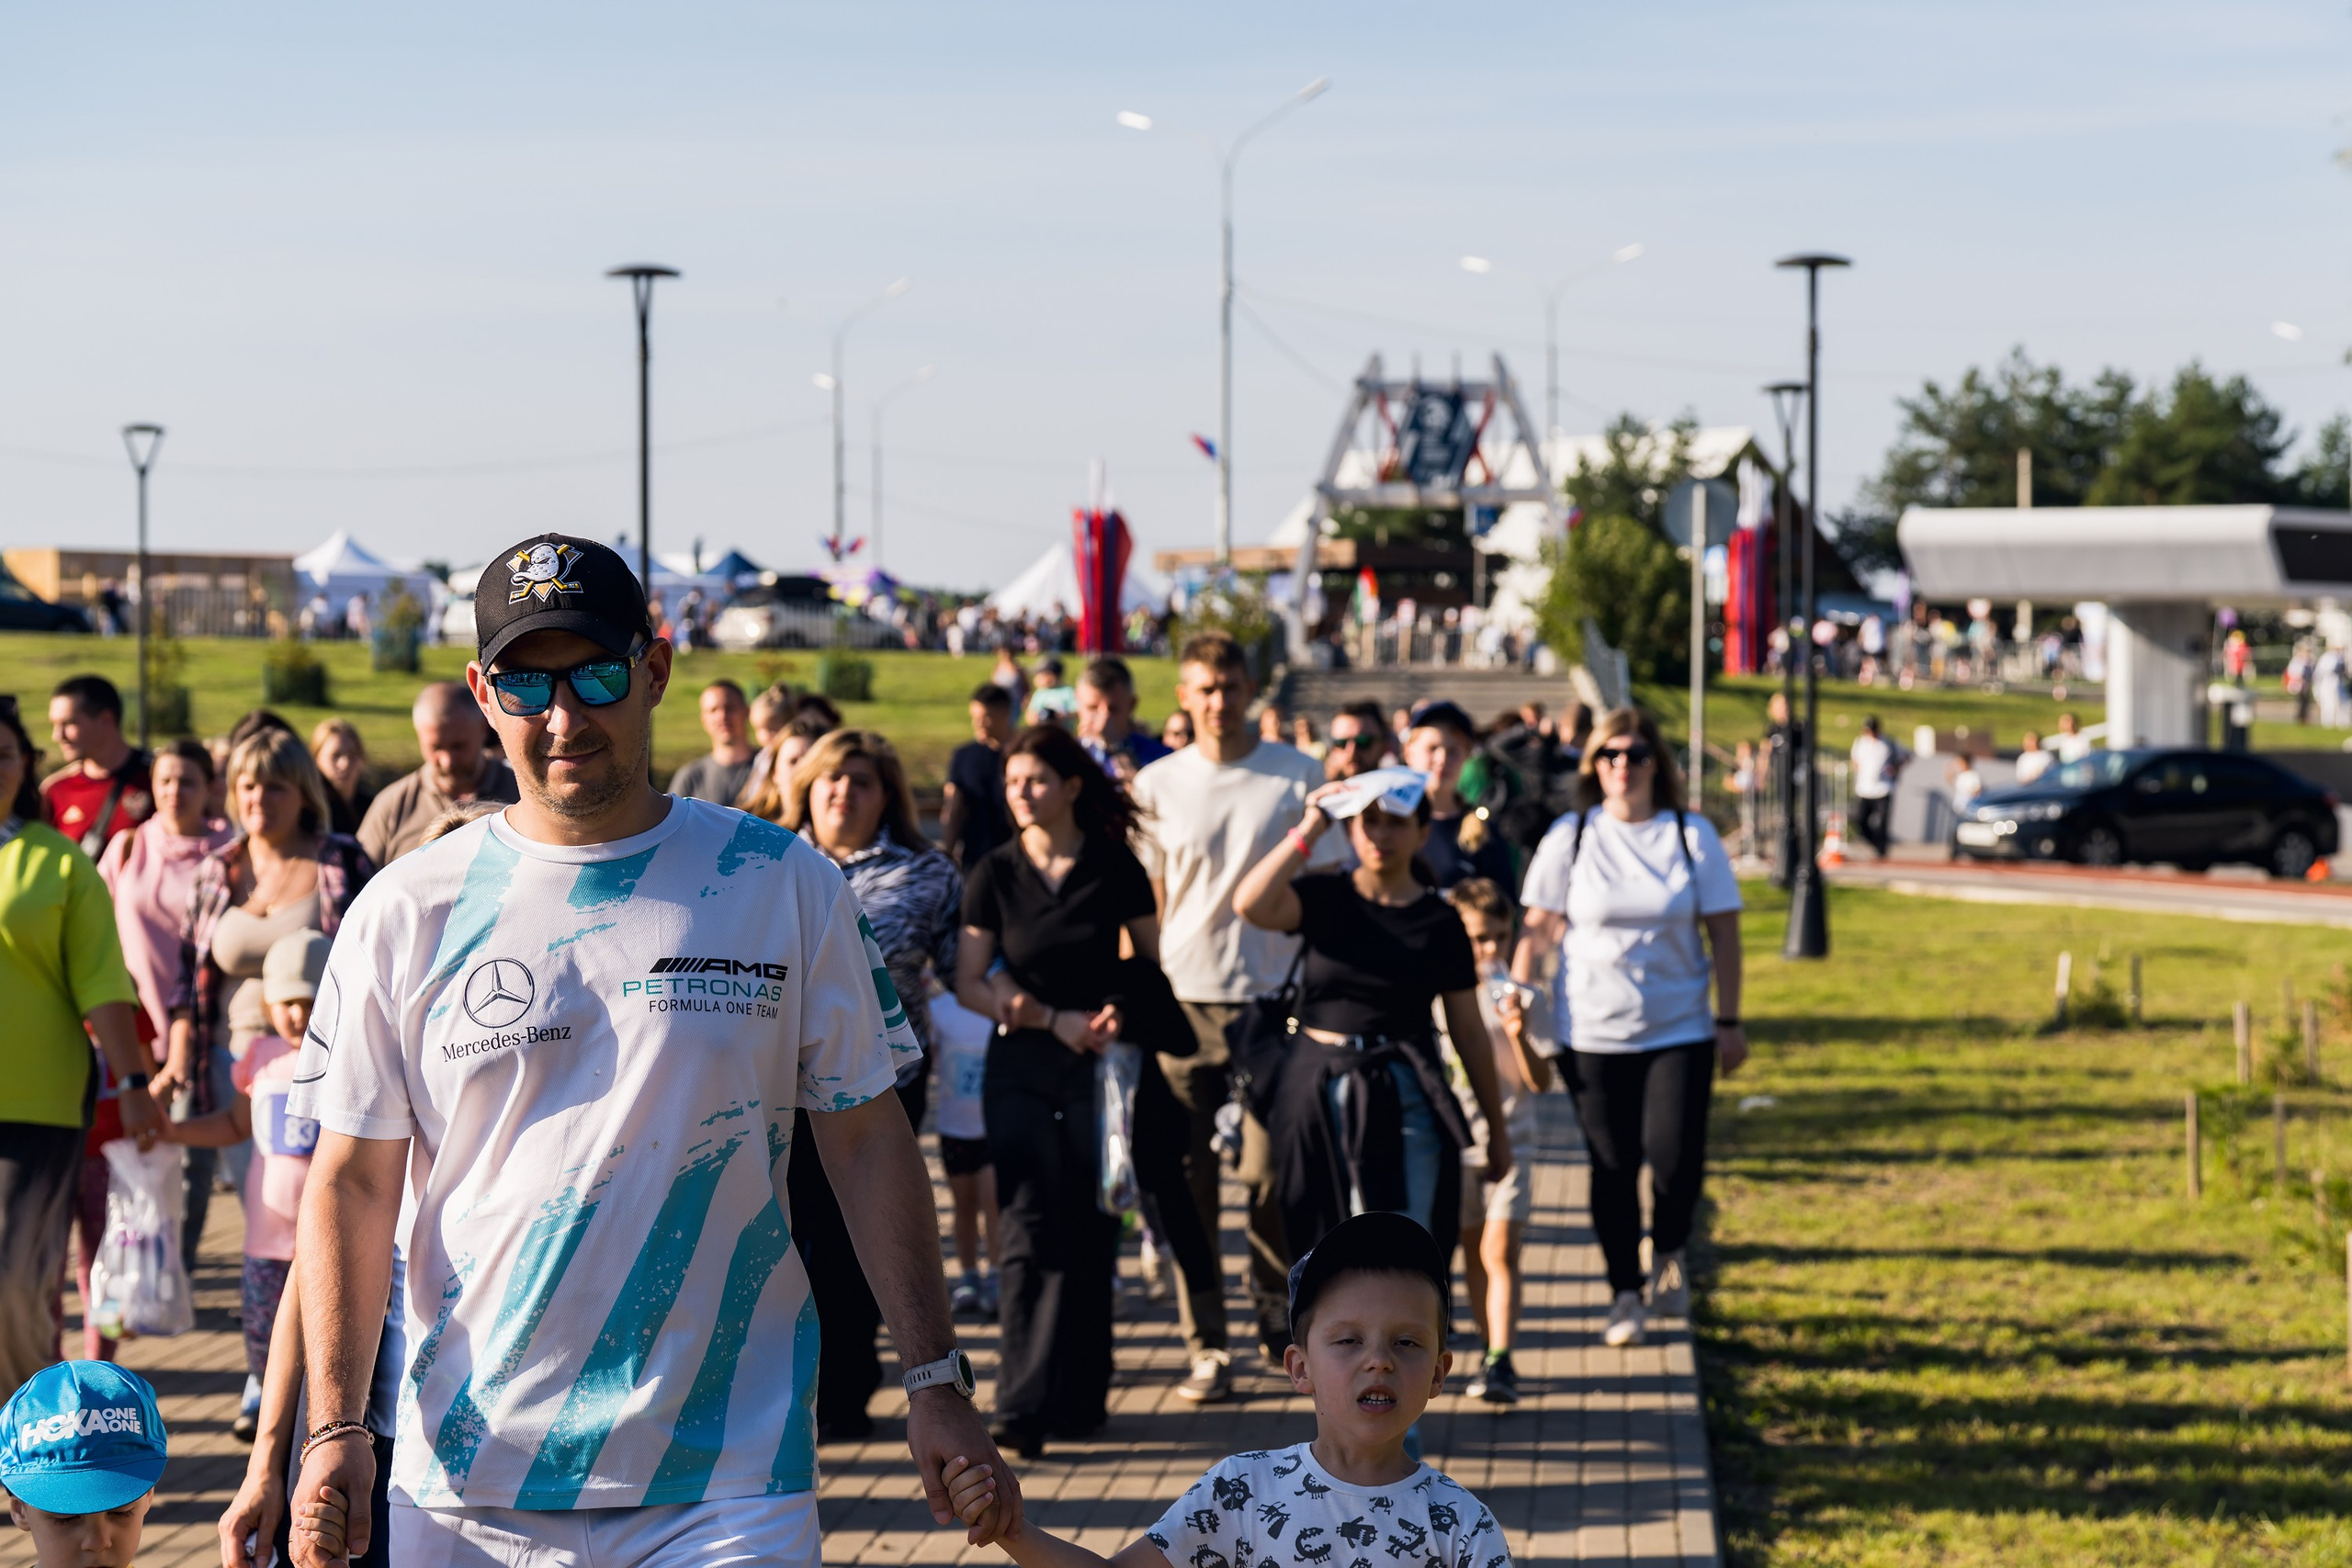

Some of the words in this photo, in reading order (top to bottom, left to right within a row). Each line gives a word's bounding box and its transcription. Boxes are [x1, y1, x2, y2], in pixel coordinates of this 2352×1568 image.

[695, 958, 788, 981] AMG
[623, 978, 783, 1002] PETRONAS
[649, 998, 721, 1013] FORMULA
[726, 1001, 752, 1016] ONE
[756, 1004, 779, 1020] TEAM
[441, 1025, 571, 1063] Mercedes-Benz
[21, 1408, 110, 1451] HOKA
[102, 1407, 137, 1420] ONE
[108, 1420, 141, 1434] ONE
